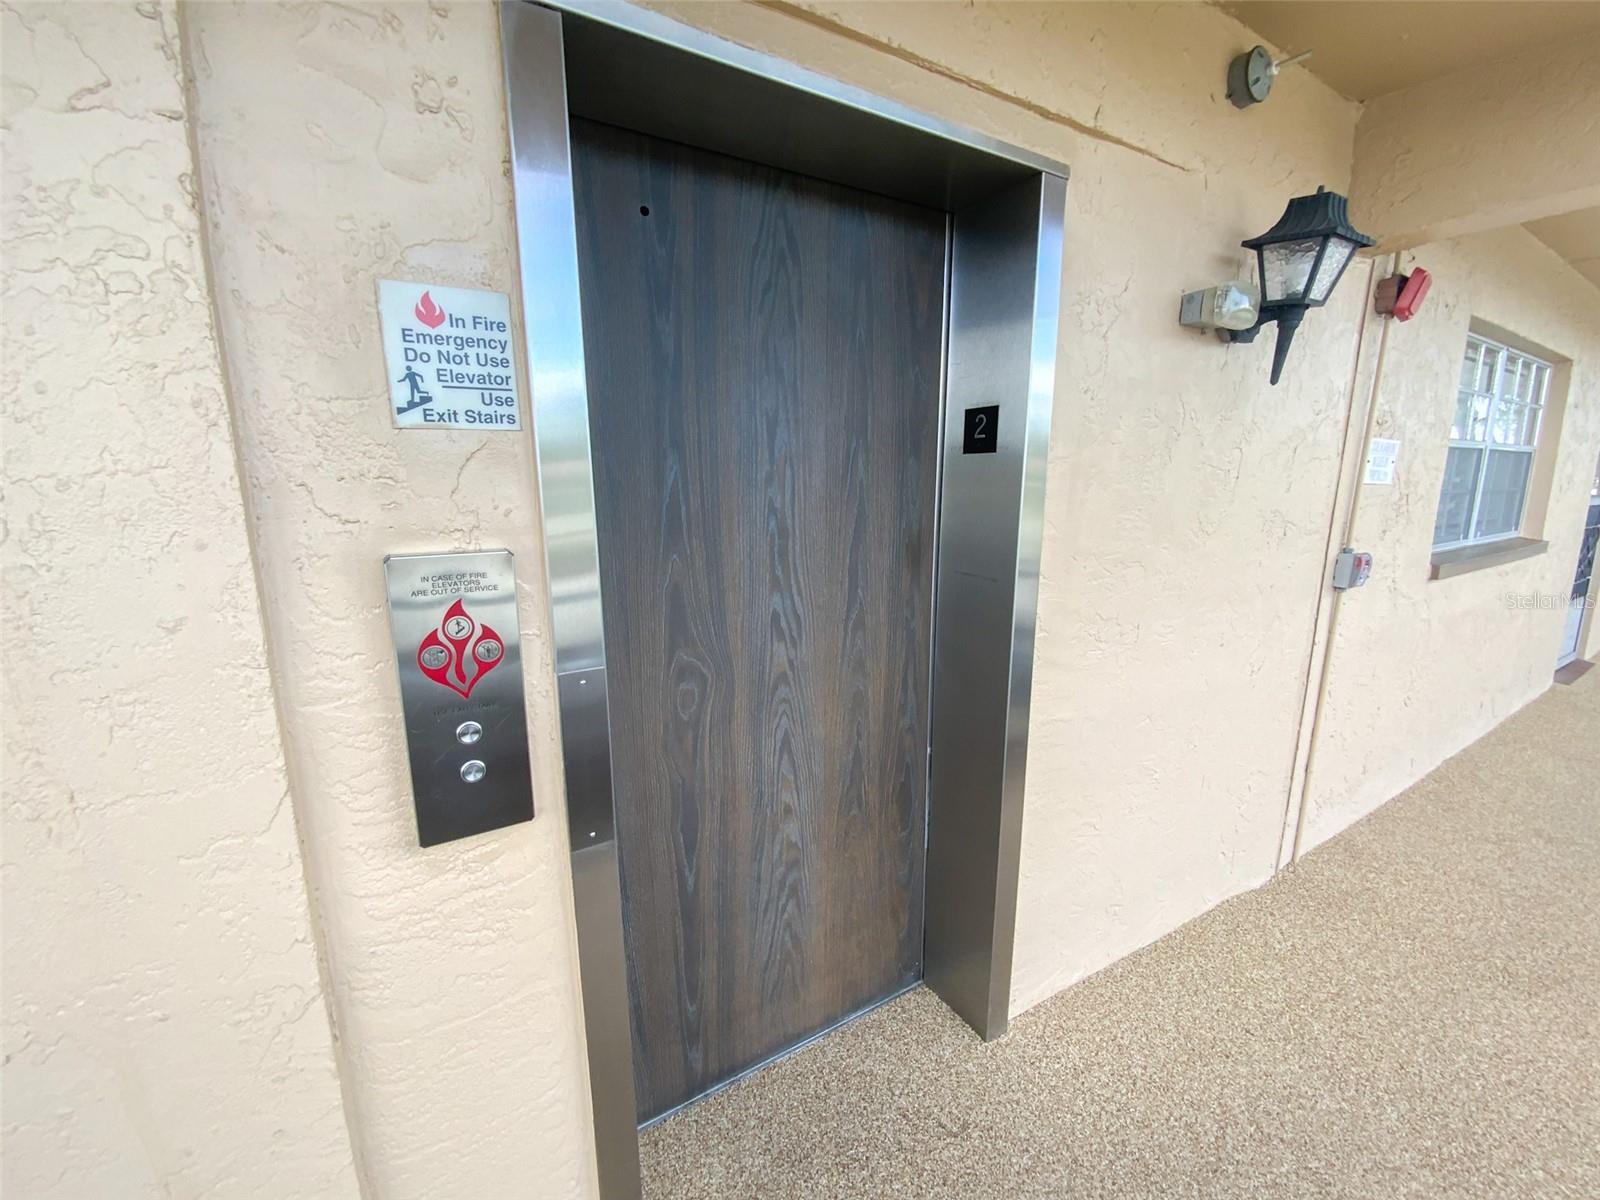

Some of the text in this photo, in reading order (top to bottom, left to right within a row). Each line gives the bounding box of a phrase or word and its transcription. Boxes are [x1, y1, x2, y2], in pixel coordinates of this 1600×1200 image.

[449, 313, 507, 333] In Fire
[401, 328, 508, 354] Emergency
[403, 347, 510, 368] Do Not Use
[436, 368, 512, 386] Elevator
[481, 392, 515, 407] Use
[422, 408, 516, 425] Exit Stairs
[974, 414, 987, 439] 2
[431, 574, 454, 582] CASE
[455, 572, 467, 580] OF
[431, 579, 481, 589] ELEVATORS
[411, 589, 429, 597] ARE
[430, 588, 448, 596] OUT
[464, 584, 499, 593] SERVICE
